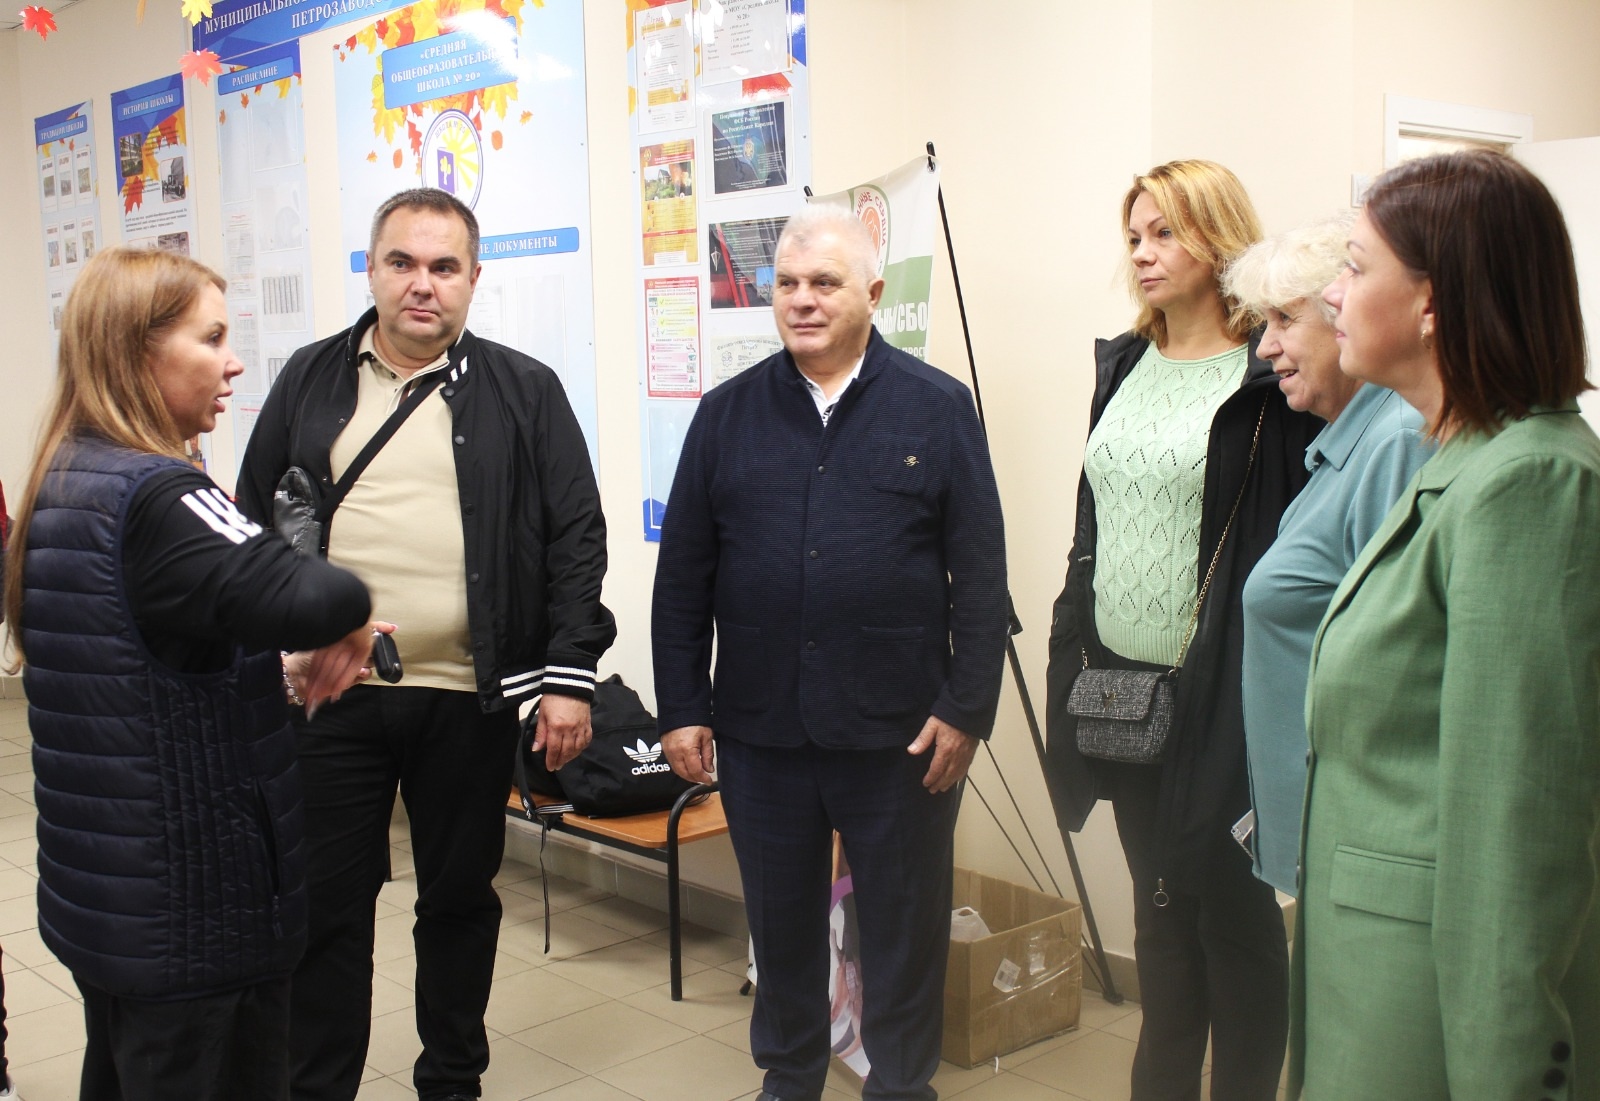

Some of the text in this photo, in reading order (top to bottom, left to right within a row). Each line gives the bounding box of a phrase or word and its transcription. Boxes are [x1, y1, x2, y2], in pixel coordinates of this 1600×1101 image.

[205, 0, 307, 34] МУНИЦИПАЛЬН
[292, 0, 382, 28] ПЕТРОЗАВОД
[420, 39, 467, 59] «СРЕДНЯЯ
[232, 65, 279, 87] РАСПИСАНИЕ
[417, 72, 481, 93] ШКОЛА № 20»
[123, 94, 174, 116] ИСТОРИЯ ШКОЛЫ
[492, 235, 558, 254] ДОКУМЕНТЫ
[896, 301, 929, 333] СБО
[631, 762, 671, 776] adidas
